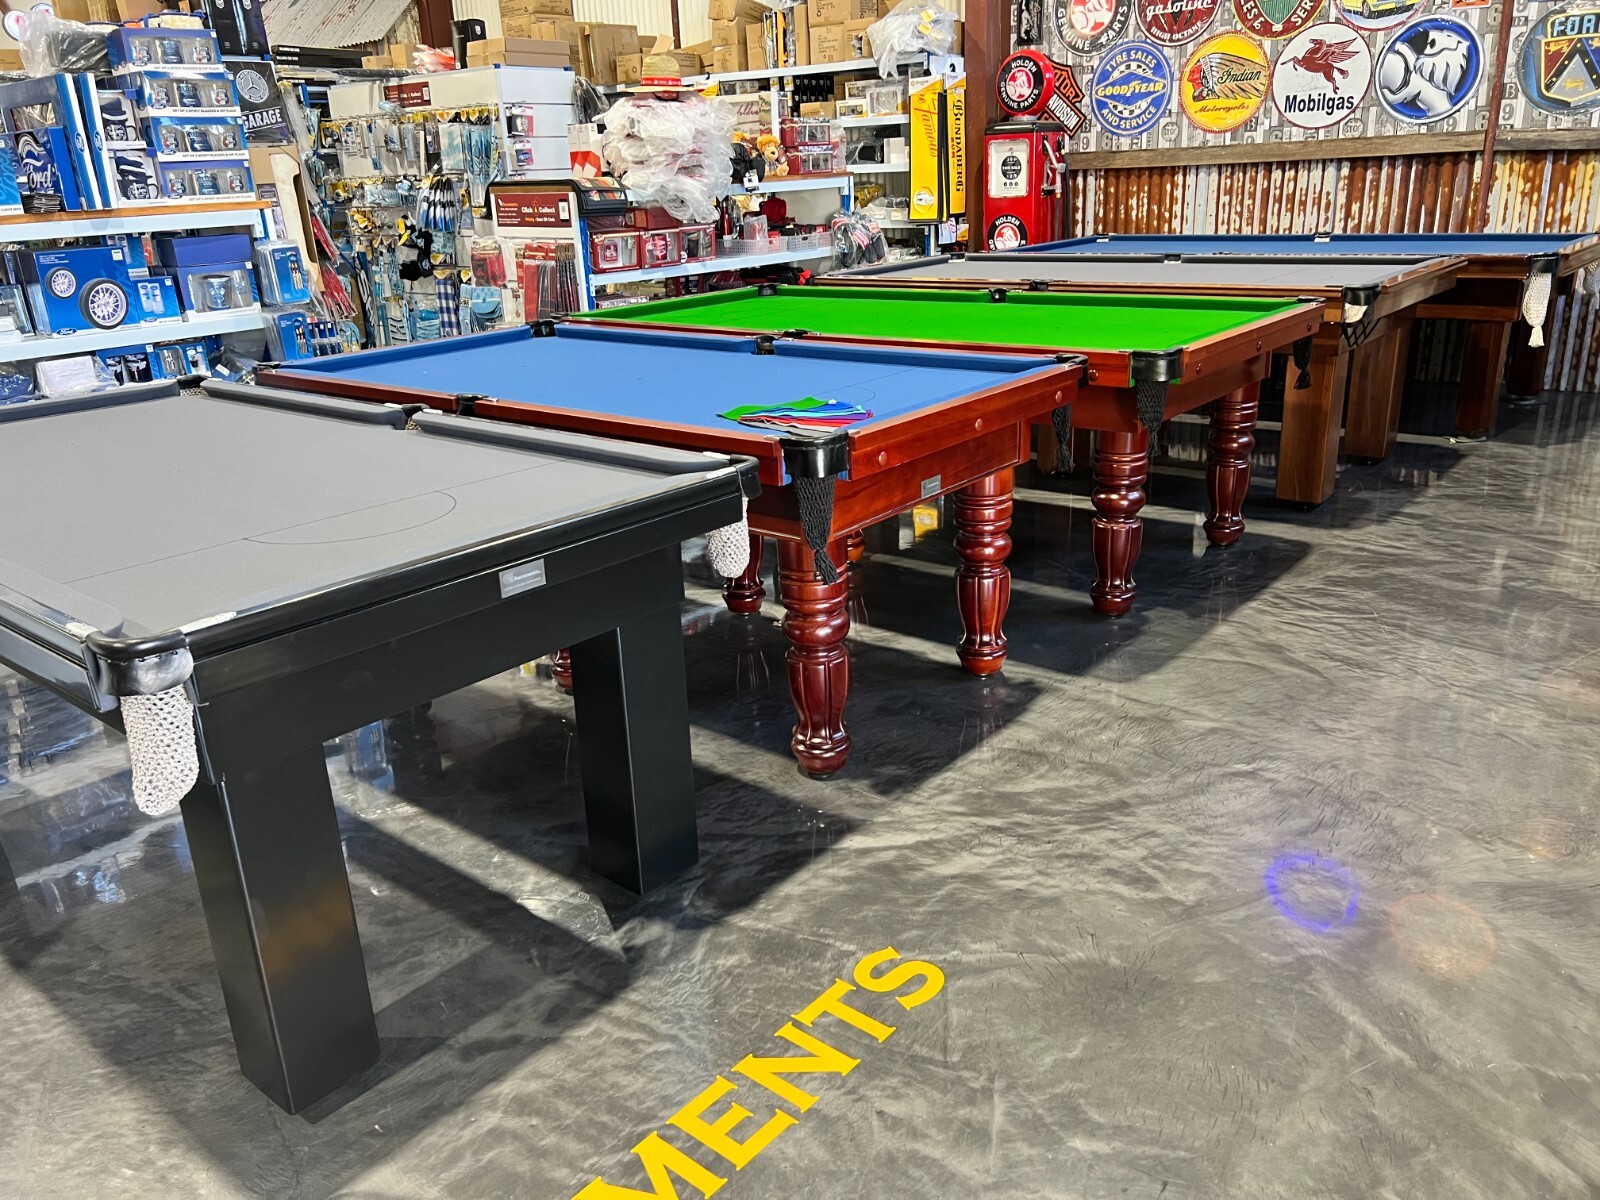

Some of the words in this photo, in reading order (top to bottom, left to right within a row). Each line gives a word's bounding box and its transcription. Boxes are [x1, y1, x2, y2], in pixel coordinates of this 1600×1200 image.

[1057, 7, 1091, 51] GENUINE
[1150, 26, 1171, 40] HIGH
[1172, 20, 1202, 41] OCTANE
[1553, 15, 1600, 37] FOR
[1011, 59, 1038, 73] HOLDEN
[1105, 52, 1129, 72] TYRE
[1129, 50, 1157, 68] SALES
[1217, 67, 1262, 84] Indian
[1000, 81, 1019, 109] GENUINE
[1020, 88, 1039, 109] PARTS
[1284, 92, 1355, 116] Mobilgas
[242, 108, 283, 130] GARAGE
[1047, 94, 1080, 131] AVIDSON
[1101, 108, 1120, 126] AND
[1120, 105, 1157, 129] SERVICE
[1194, 102, 1250, 114] Motorcycles
[953, 99, 964, 192] BUNDABERG
[995, 216, 1020, 227] HOLDEN
[571, 946, 945, 1200] MENTS
